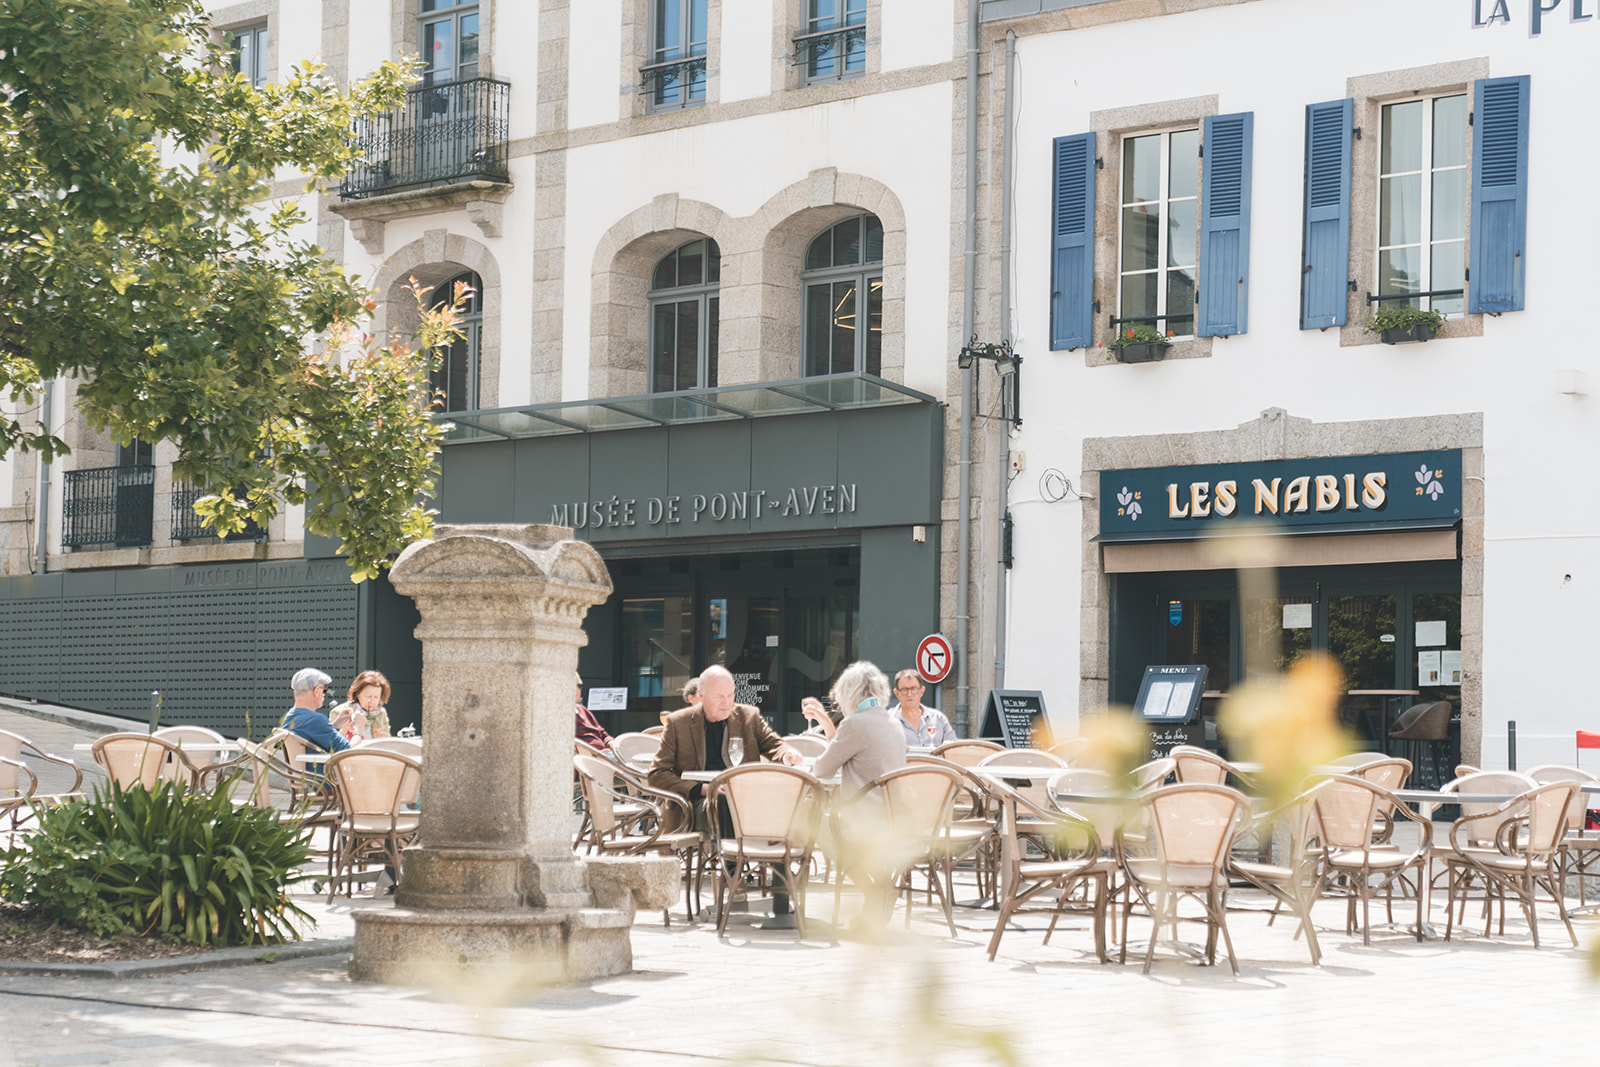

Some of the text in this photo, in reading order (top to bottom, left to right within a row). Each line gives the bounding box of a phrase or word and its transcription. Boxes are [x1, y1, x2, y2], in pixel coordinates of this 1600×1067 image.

[1472, 0, 1600, 38] LA PL
[550, 496, 636, 529] MUSÉE
[648, 495, 681, 525] DE
[1167, 471, 1388, 521] LES NABIS
[184, 567, 231, 586] MUSÉE
[236, 568, 254, 585] DE
